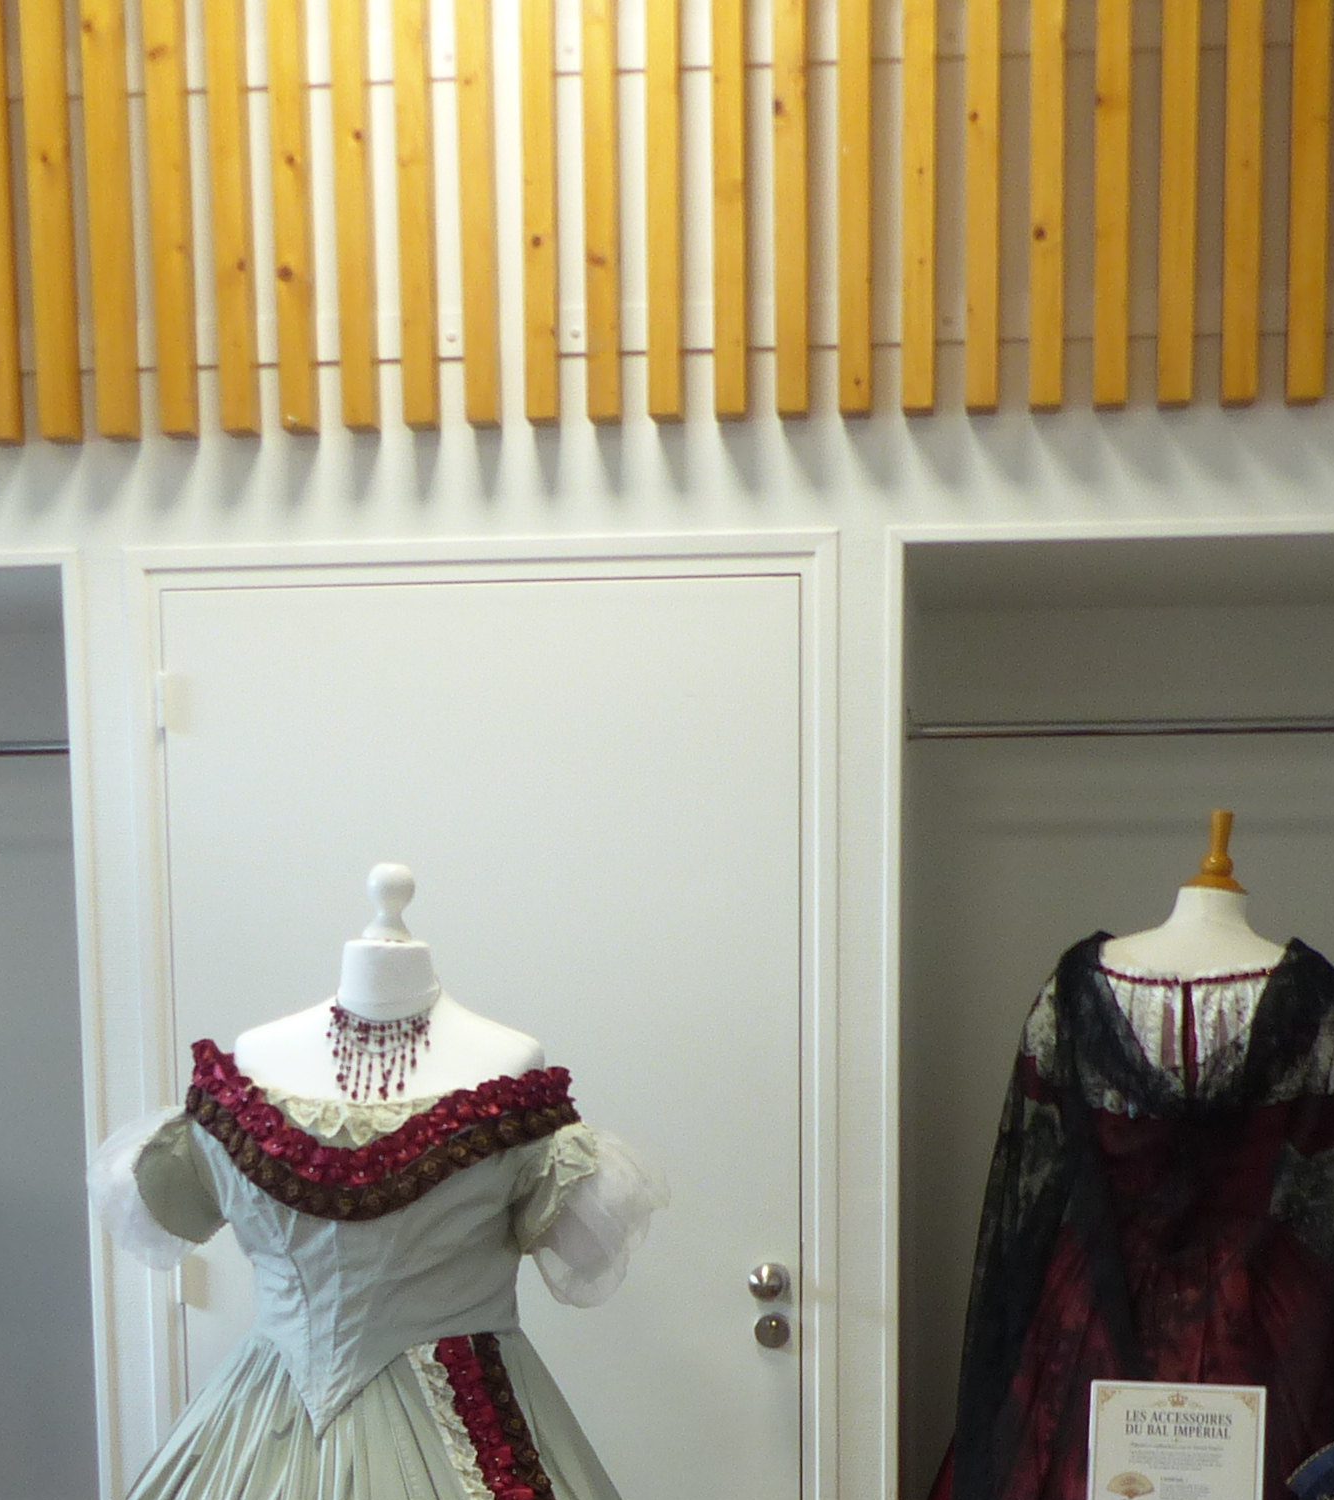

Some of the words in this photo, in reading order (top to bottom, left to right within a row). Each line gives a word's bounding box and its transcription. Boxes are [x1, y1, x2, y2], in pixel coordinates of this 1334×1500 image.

[1125, 1410, 1147, 1423] LES
[1151, 1411, 1233, 1426] ACCESSOIRES
[1125, 1424, 1142, 1436] DU
[1147, 1424, 1169, 1437] BAL
